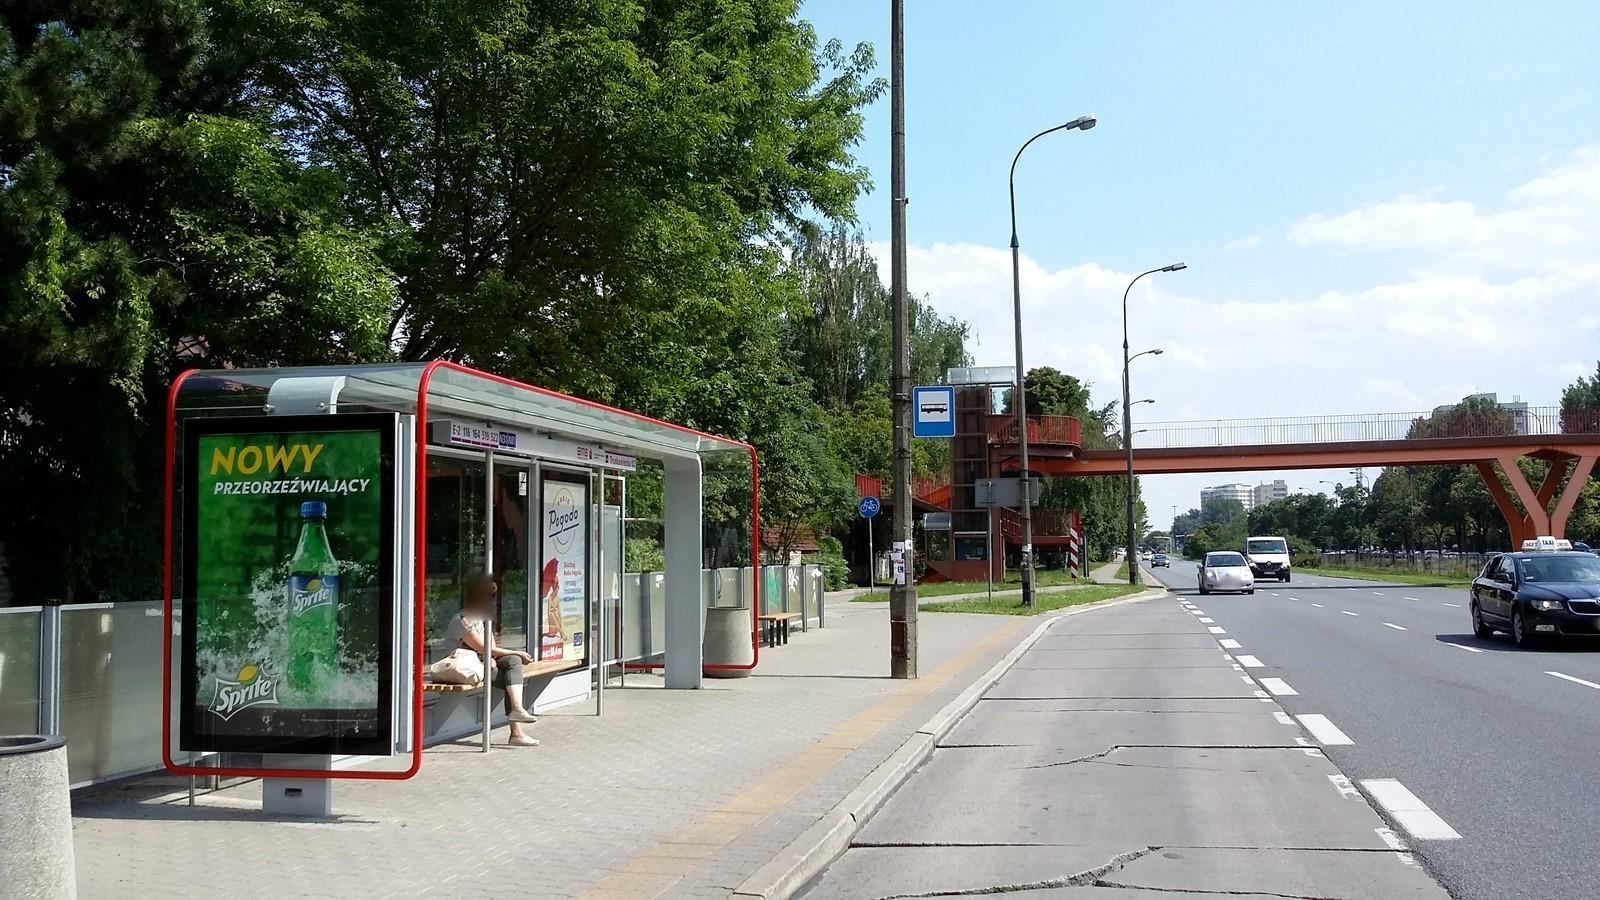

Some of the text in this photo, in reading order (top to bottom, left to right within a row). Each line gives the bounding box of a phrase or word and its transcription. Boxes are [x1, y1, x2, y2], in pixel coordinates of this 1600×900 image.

[463, 426, 471, 437] 116
[210, 444, 324, 475] NOWY
[214, 477, 371, 496] PRZEORZEŹWIAJĄCY
[293, 586, 330, 612] Sprite
[216, 674, 272, 713] Sprite
